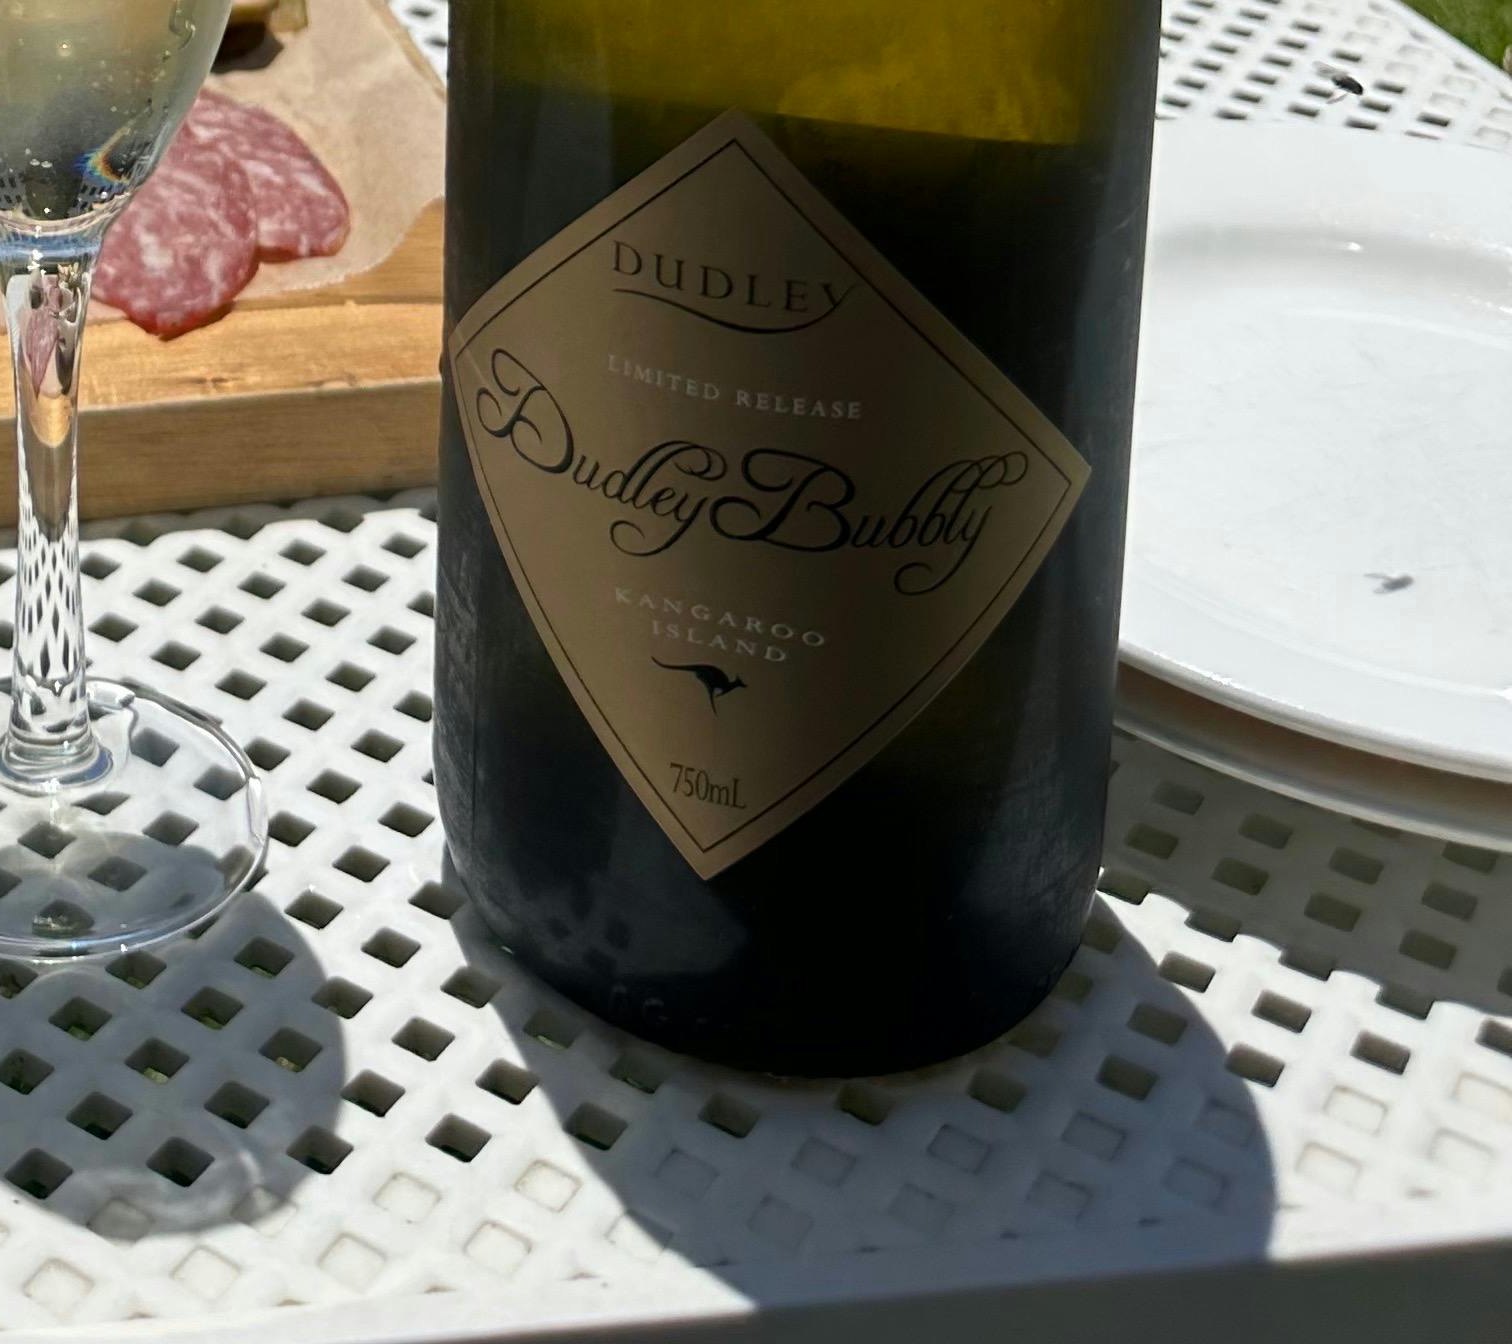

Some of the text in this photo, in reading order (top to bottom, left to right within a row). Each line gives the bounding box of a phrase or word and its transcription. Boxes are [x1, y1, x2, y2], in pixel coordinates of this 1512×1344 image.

[613, 240, 858, 314] DUDLEY
[607, 355, 862, 421] LIMITED RELEASE
[477, 349, 1029, 596] Dudley Bubbly
[614, 587, 826, 648] KANGAROO
[651, 620, 787, 663] ISLAND
[670, 762, 748, 810] 750mL
